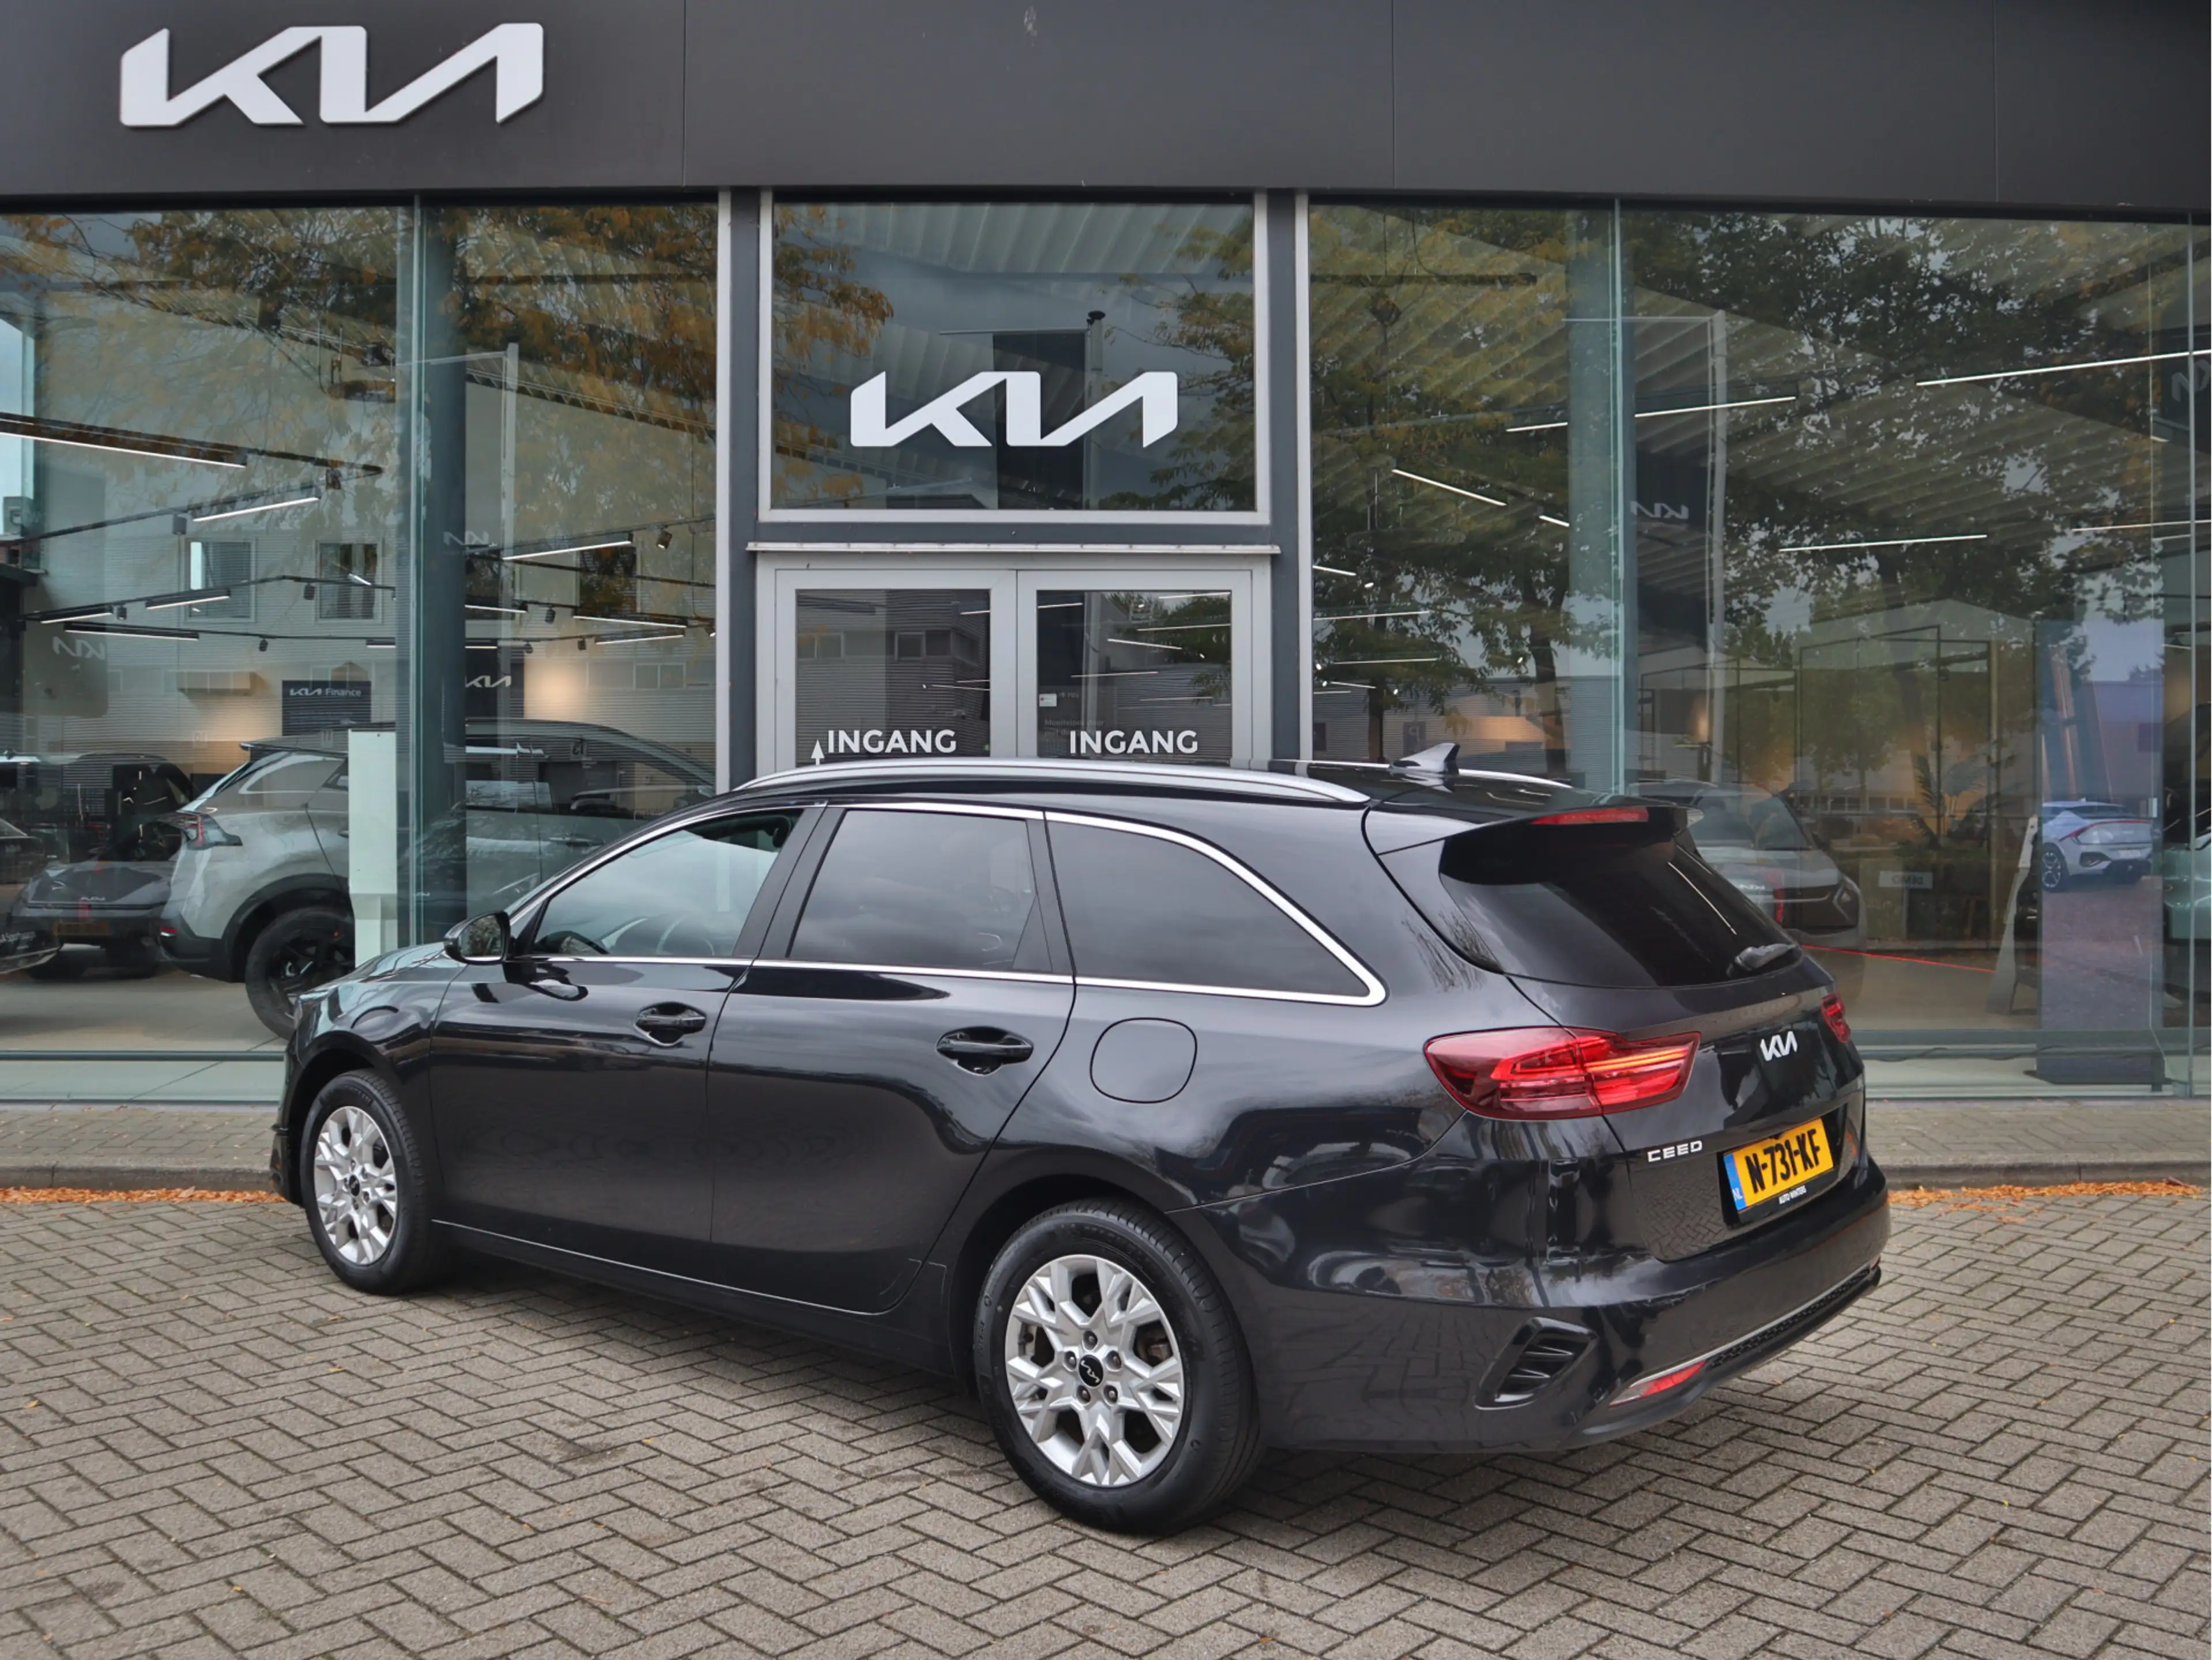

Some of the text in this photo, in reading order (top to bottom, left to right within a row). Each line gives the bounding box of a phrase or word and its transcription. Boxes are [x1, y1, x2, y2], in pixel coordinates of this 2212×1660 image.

[120, 22, 544, 127] KIA
[850, 371, 1178, 448] KIA
[289, 688, 361, 697] KIA Finance
[465, 676, 511, 688] KIA
[828, 729, 956, 753] INGANG
[1070, 730, 1198, 754] INGANG
[1760, 1031, 1798, 1061] KIA
[1648, 1141, 1702, 1162] CEED
[1745, 1129, 1820, 1194] N-731-KF
